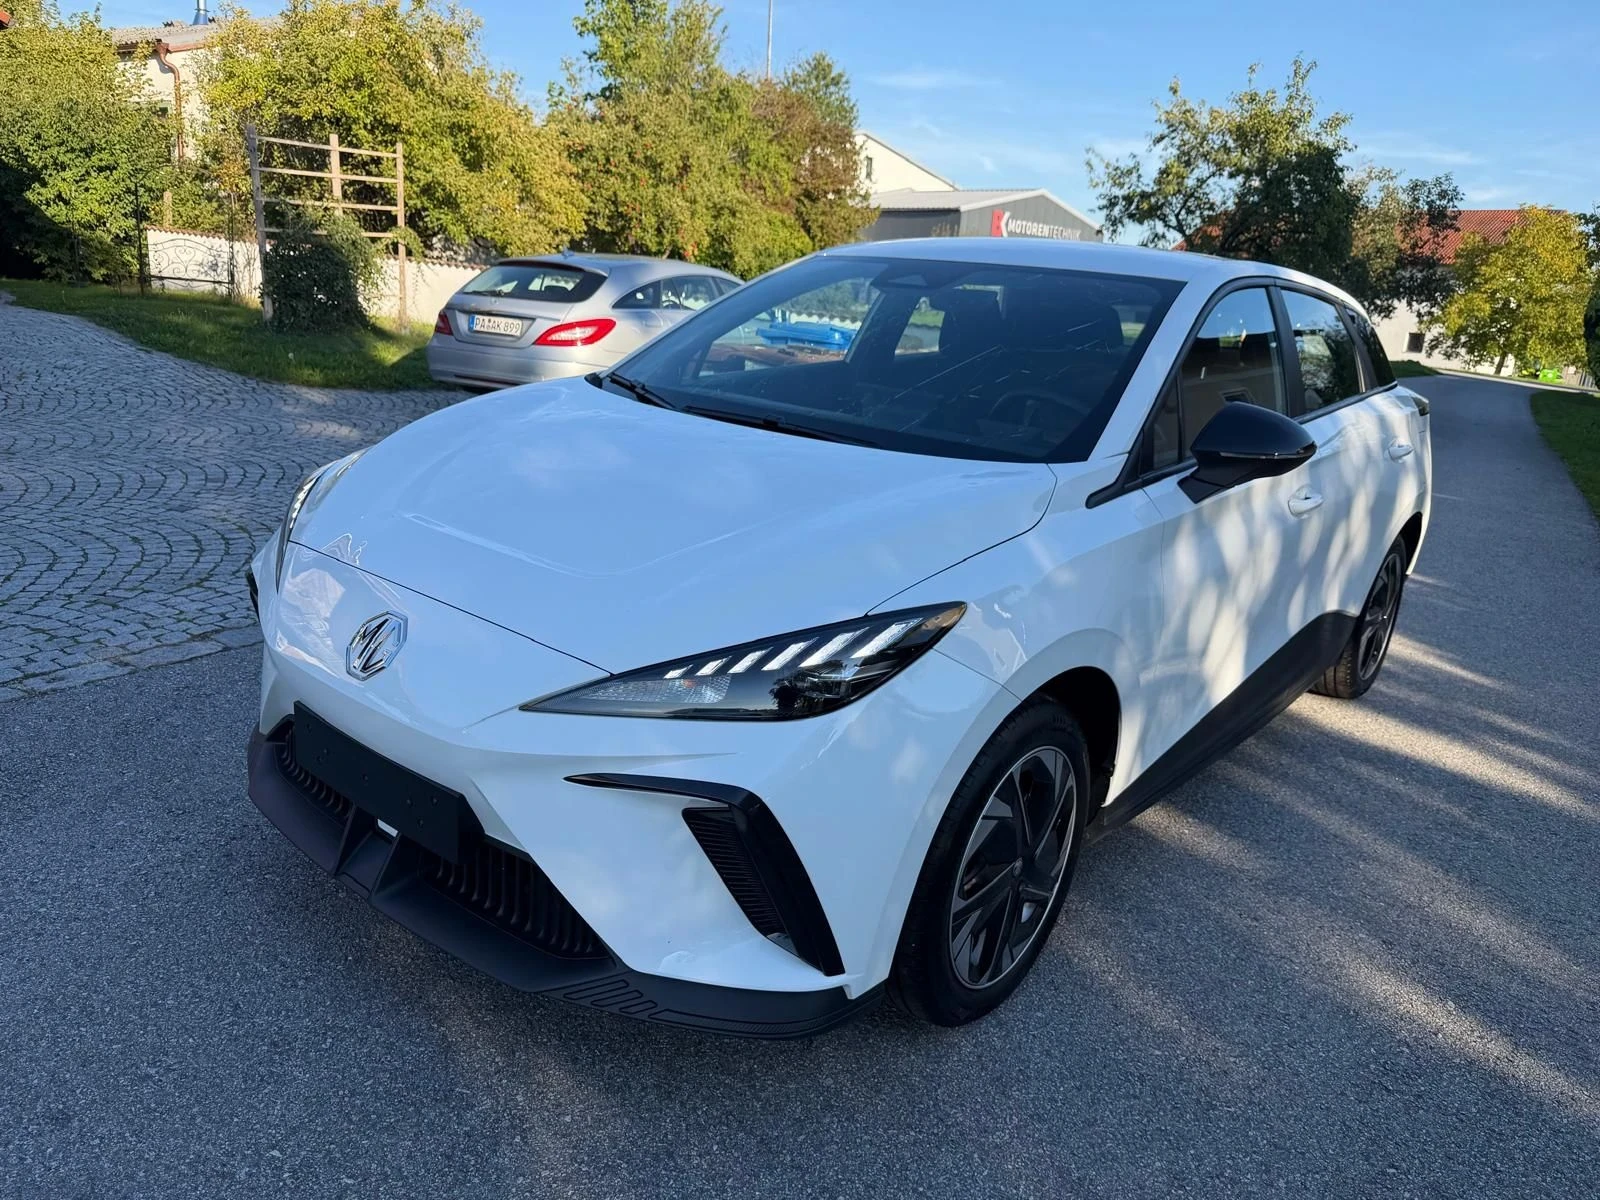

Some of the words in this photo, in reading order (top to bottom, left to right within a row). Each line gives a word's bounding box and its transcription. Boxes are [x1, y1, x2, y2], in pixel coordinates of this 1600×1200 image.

[1007, 219, 1081, 240] MOTORENTECHNIK
[503, 322, 520, 333] 899
[350, 618, 402, 673] MG
